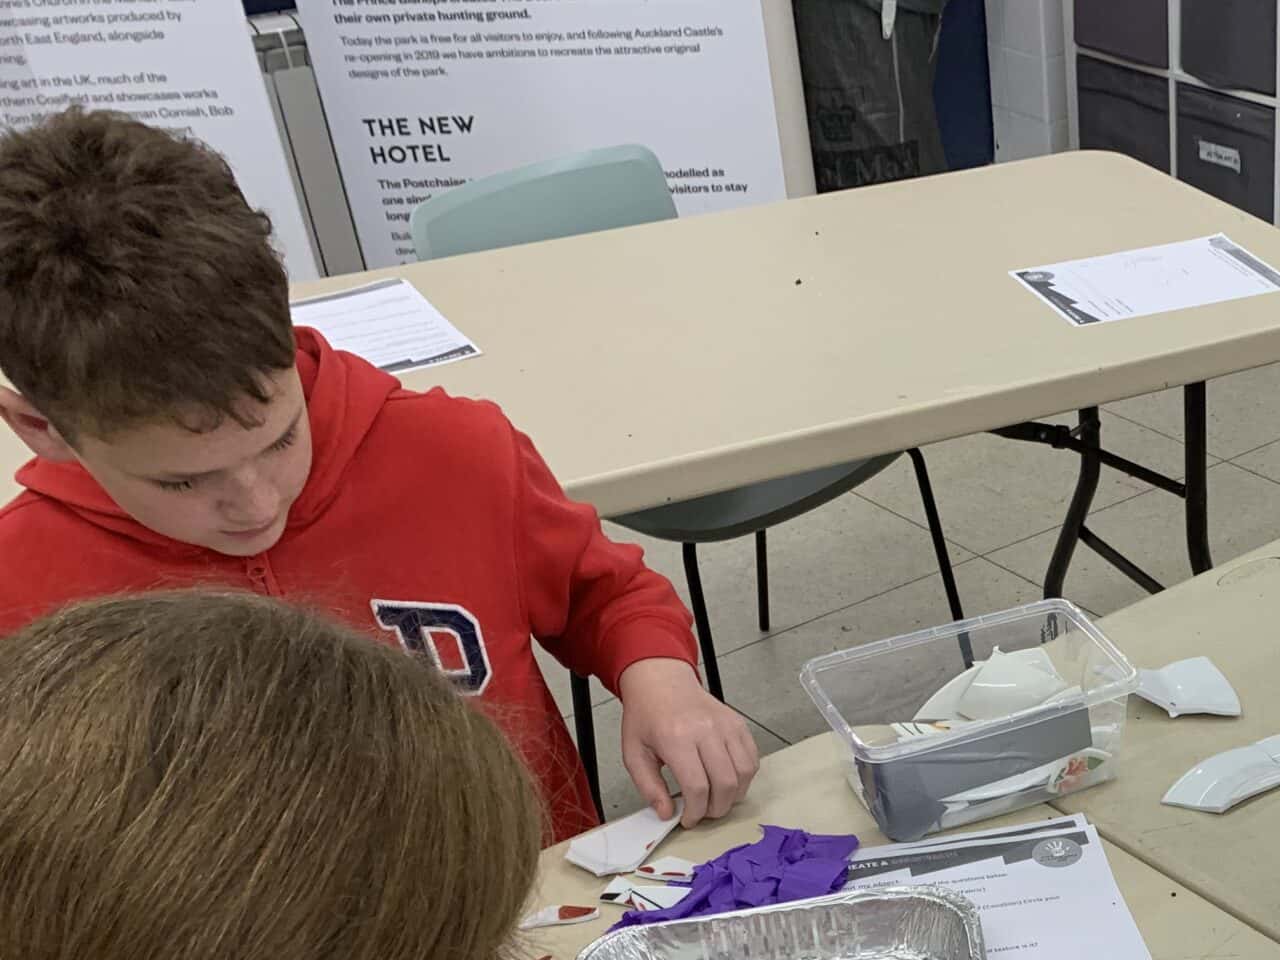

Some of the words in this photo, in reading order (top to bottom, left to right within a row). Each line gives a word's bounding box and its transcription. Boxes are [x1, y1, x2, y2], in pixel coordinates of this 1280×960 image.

[52, 14, 105, 26] artworks
[106, 12, 165, 24] produced
[166, 10, 181, 22] by
[334, 12, 362, 24] their
[365, 14, 390, 23] own
[393, 11, 436, 24] private
[438, 9, 483, 22] hunting
[486, 7, 532, 21] ground.
[25, 34, 51, 45] East
[54, 31, 106, 44] England,
[108, 30, 164, 42] alongside
[341, 35, 372, 47] Today
[374, 34, 391, 45] the
[394, 33, 418, 46] park
[420, 33, 429, 43] is
[430, 32, 450, 44] free
[453, 32, 468, 43] for
[470, 31, 482, 42] all
[484, 31, 521, 42] visitors
[522, 31, 534, 41] to
[566, 29, 586, 40] and
[587, 28, 633, 40] following
[634, 26, 682, 38] Auckland
[683, 25, 723, 37] Castle's
[403, 50, 413, 60] in
[442, 51, 457, 59] we
[458, 48, 484, 59] have
[486, 47, 536, 58] ambitions
[538, 46, 549, 56] to
[550, 45, 593, 56] recreate
[595, 44, 611, 55] the
[614, 43, 661, 54] attractive
[40, 77, 50, 88] in
[52, 75, 73, 87] the
[98, 73, 132, 84] much
[133, 72, 146, 83] of
[147, 72, 167, 83] the
[348, 68, 389, 79] designs
[390, 66, 401, 78] of
[402, 66, 421, 77] the
[91, 92, 114, 103] and
[116, 90, 181, 101] showcases
[182, 88, 219, 99] works
[362, 117, 411, 136] THE
[418, 115, 474, 136] NEW
[369, 144, 451, 164] HOTEL
[711, 168, 725, 177] as
[378, 178, 401, 189] The
[670, 183, 710, 194] visitors
[711, 183, 723, 193] to
[725, 183, 748, 194] stay
[382, 196, 404, 206] one
